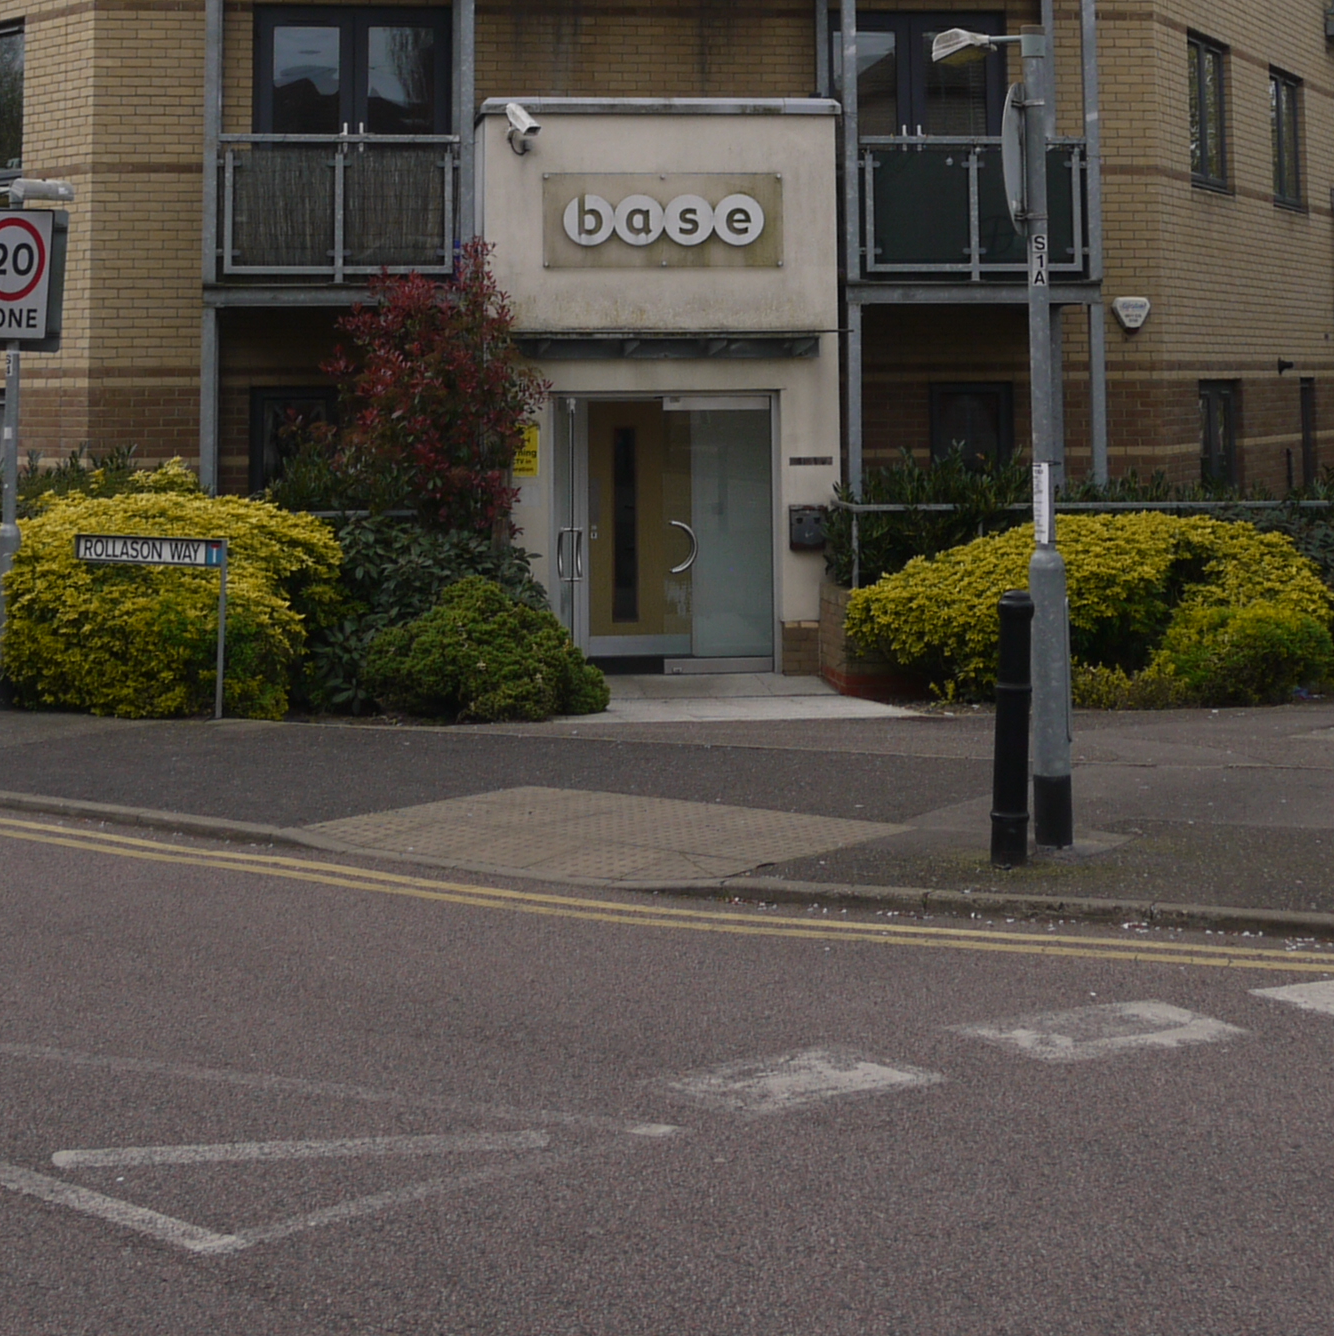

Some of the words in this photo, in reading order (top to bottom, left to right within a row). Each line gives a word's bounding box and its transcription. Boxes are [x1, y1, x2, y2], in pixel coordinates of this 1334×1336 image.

[576, 192, 754, 237] base
[1034, 235, 1045, 284] S1A
[83, 539, 162, 560] ROLLASON
[169, 542, 201, 562] WAY
